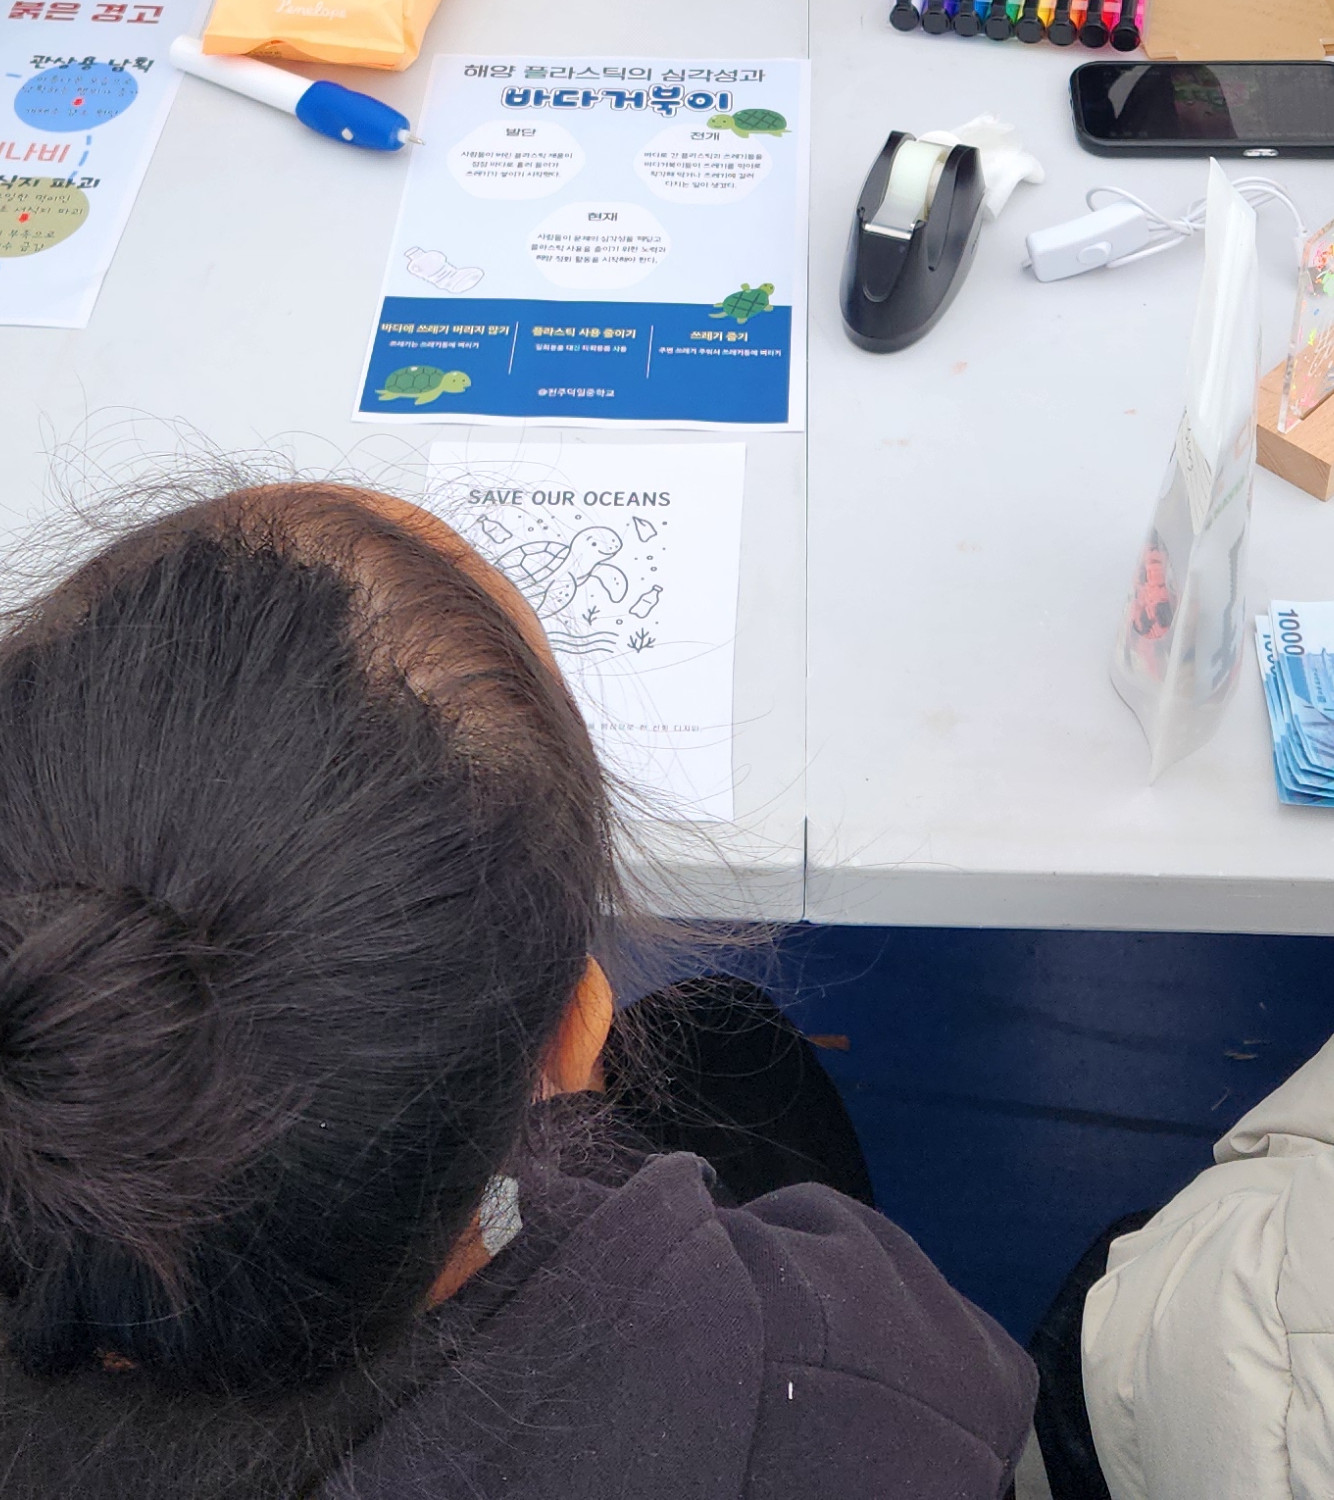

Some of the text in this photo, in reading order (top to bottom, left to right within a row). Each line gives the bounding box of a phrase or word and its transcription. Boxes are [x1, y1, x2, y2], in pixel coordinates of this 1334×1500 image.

[7, 0, 82, 21] 붉은
[90, 3, 165, 24] 경고
[29, 55, 155, 74] 관상용 남획
[463, 64, 767, 83] 해양 플라스틱의 심각성과
[501, 85, 733, 118] 바다거북이
[690, 131, 721, 141] 전개
[49, 176, 101, 189] 파괴
[588, 212, 618, 221] 현재
[381, 323, 415, 333] 바다에
[417, 324, 450, 335] 쓰레기
[452, 325, 486, 336] 버리지
[532, 326, 576, 338] 플라스틱
[579, 327, 601, 338] 사용
[690, 331, 723, 342] 쓰레기
[467, 489, 672, 508] SAVE OUR OCEANS
[1278, 608, 1305, 656] 1000
